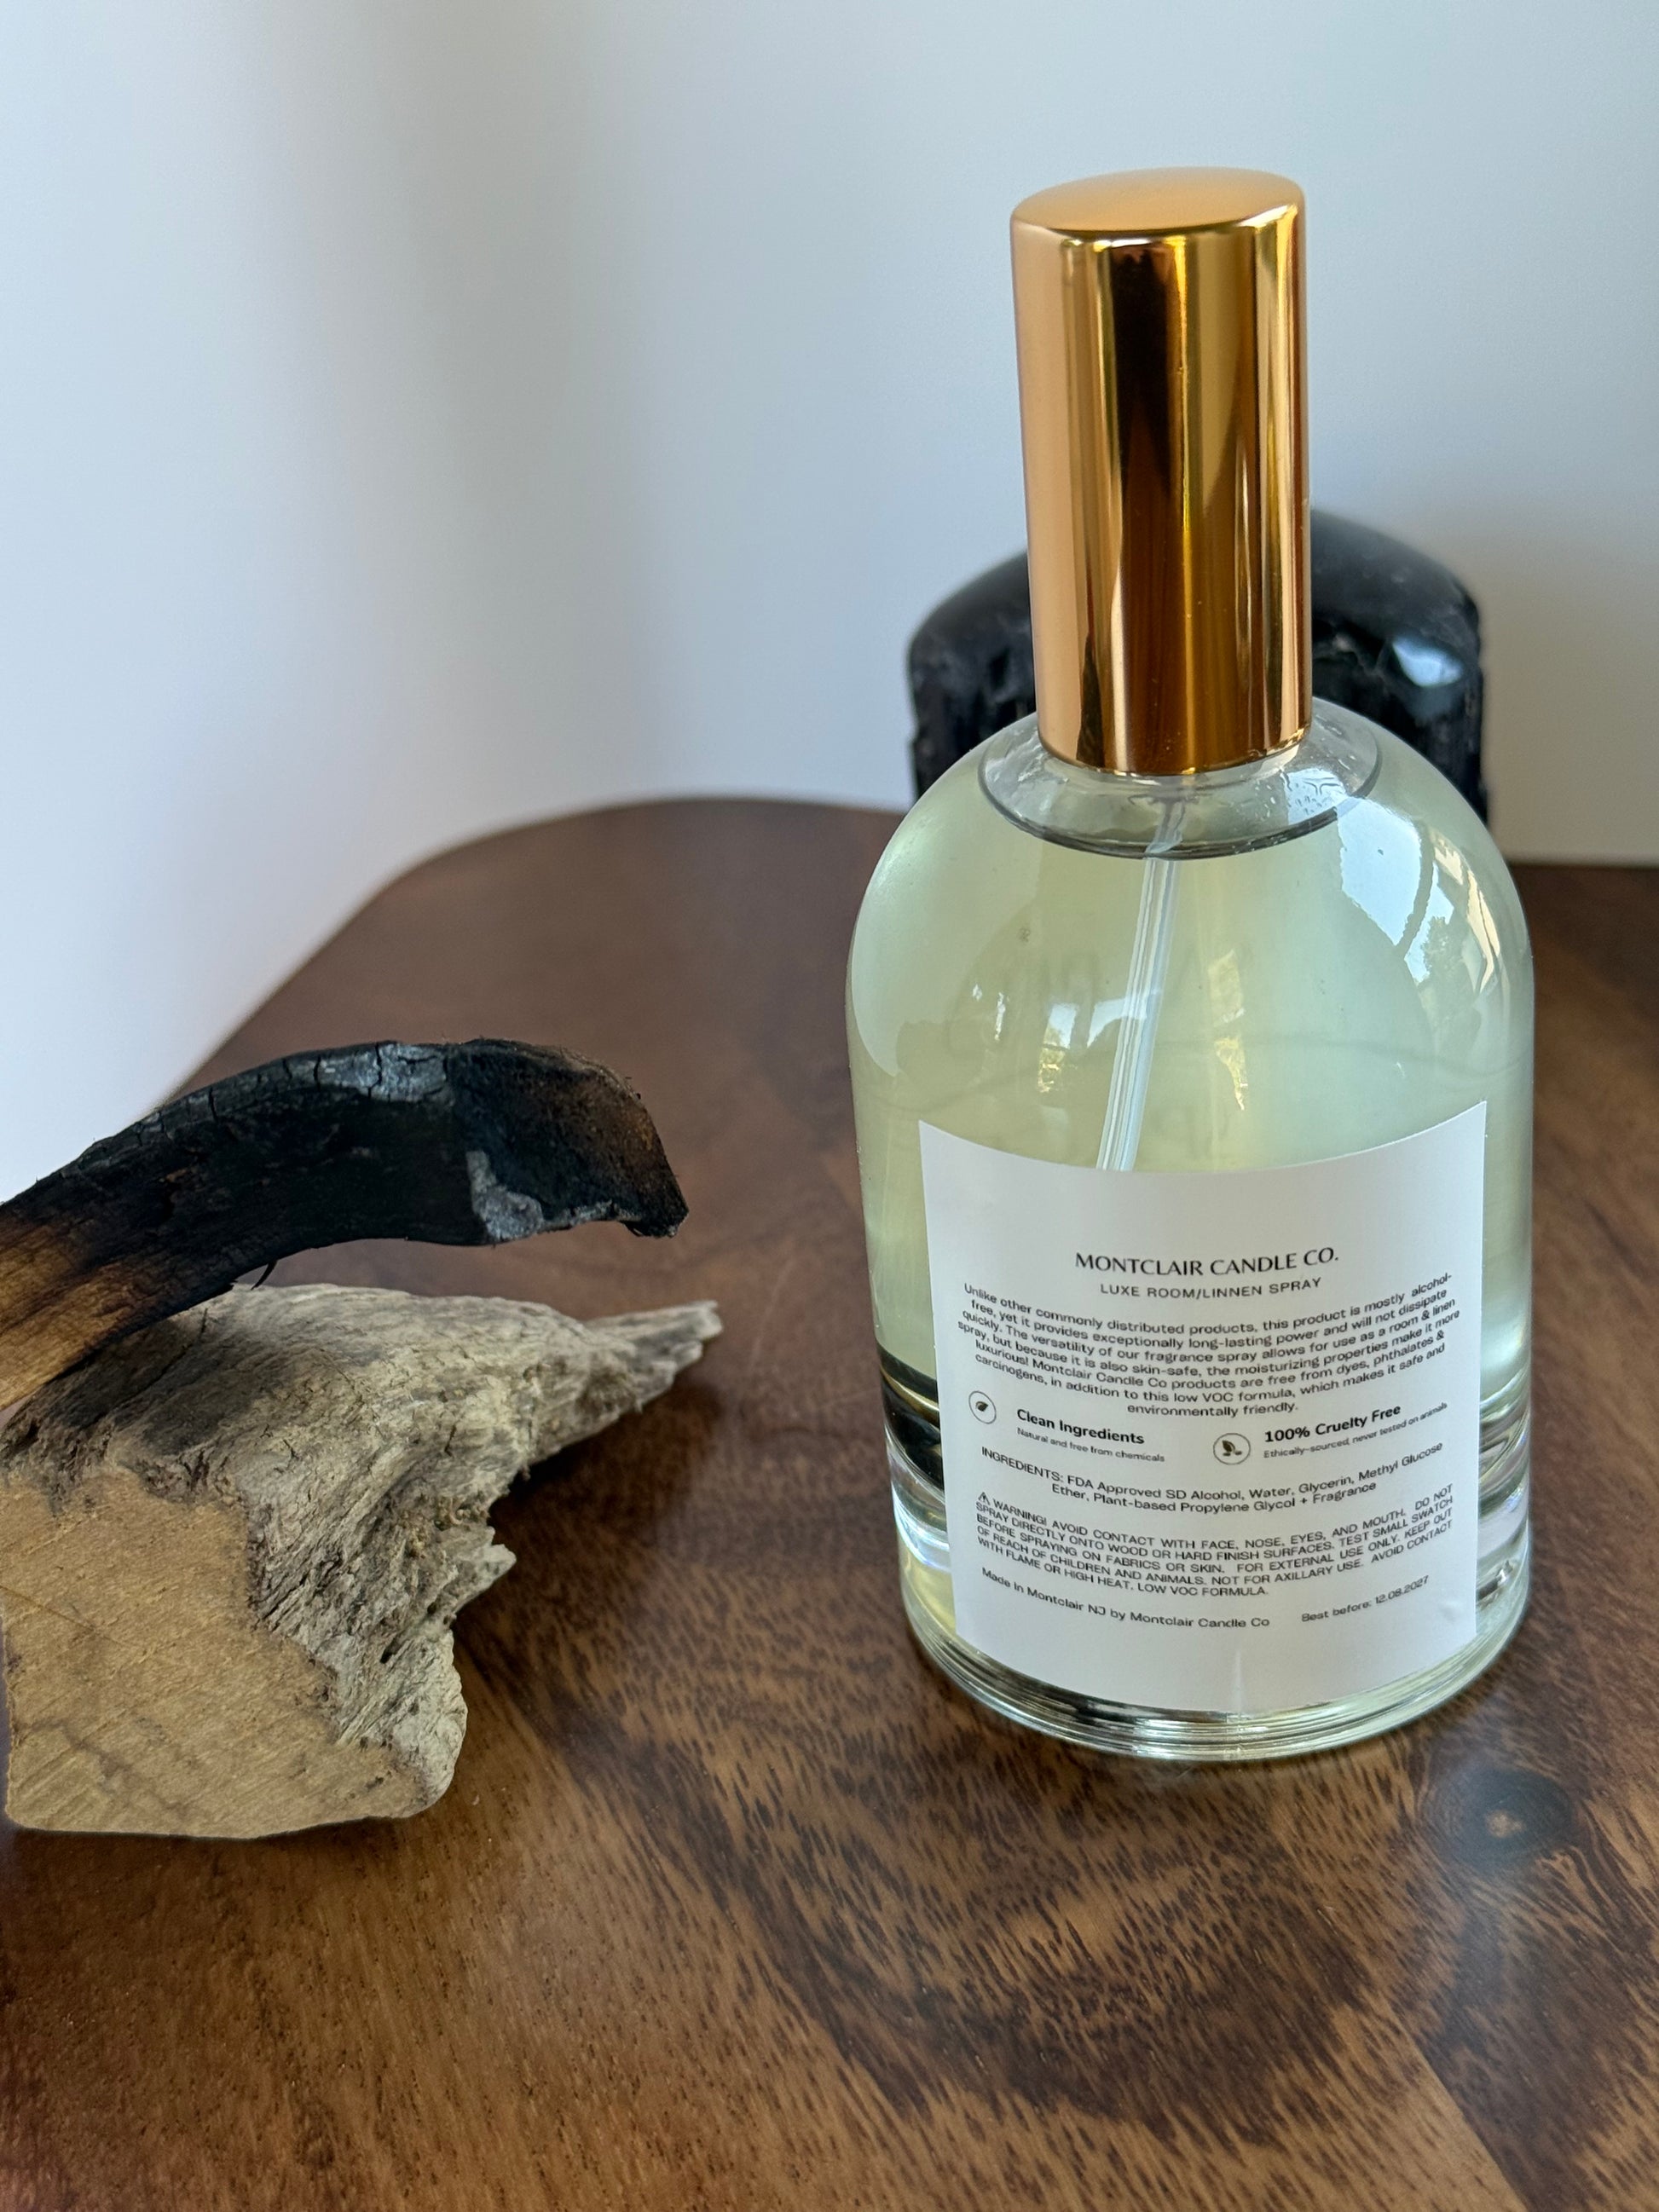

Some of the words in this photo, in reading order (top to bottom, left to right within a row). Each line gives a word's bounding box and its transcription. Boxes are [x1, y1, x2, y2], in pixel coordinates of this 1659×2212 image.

[1075, 1253, 1202, 1275] MONTCLAIR
[1211, 1253, 1297, 1275] CANDLE
[1304, 1247, 1338, 1265] CO.
[1100, 1284, 1140, 1297] LUXE
[1147, 1285, 1262, 1299] ROOM/LINNEN
[1269, 1278, 1321, 1294] SPRAY
[963, 1309, 1003, 1333] quickly.
[1006, 1325, 1028, 1339] The
[1032, 1334, 1095, 1355] versatility
[1118, 1350, 1140, 1360] our
[1145, 1351, 1213, 1364] fragrance
[1217, 1349, 1257, 1364] spray
[1262, 1345, 1306, 1359] allows
[1309, 1343, 1328, 1352] for
[1333, 1337, 1356, 1349] use
[1390, 1317, 1419, 1333] room
[1432, 1299, 1455, 1316] linen
[964, 1284, 997, 1303] Unlike
[1000, 1297, 1032, 1314] other
[1036, 1308, 1103, 1330] commonly
[1107, 1320, 1184, 1334] distributed
[1189, 1324, 1257, 1336] products,
[1263, 1320, 1289, 1331] this
[1293, 1309, 1345, 1330] product
[1364, 1292, 1405, 1313] mostly
[1412, 1273, 1452, 1297] alcohol-
[972, 1300, 997, 1318] free,
[999, 1309, 1016, 1324] yet
[1035, 1320, 1088, 1340] provides
[1093, 1332, 1183, 1350] exceptionally
[1189, 1335, 1272, 1350] long-lasting
[1277, 1330, 1318, 1345] power
[1324, 1324, 1347, 1337] and
[1352, 1316, 1372, 1330] will
[1376, 1309, 1395, 1323] not
[1398, 1289, 1447, 1314] dissipate
[958, 1321, 991, 1342] spray,
[993, 1335, 1012, 1349] but
[1016, 1342, 1067, 1362] because
[1100, 1360, 1128, 1372] also
[1132, 1365, 1202, 1377] skin-safe,
[1207, 1366, 1231, 1376] the
[1235, 1357, 1320, 1375] moisturizing
[1323, 1340, 1388, 1366] properties
[1392, 1330, 1422, 1345] make
[1436, 1309, 1460, 1330] more
[1033, 1359, 1092, 1379] Montclair
[1096, 1372, 1143, 1386] Candle
[1148, 1377, 1166, 1388] Co
[1171, 1379, 1235, 1390] products
[1240, 1377, 1263, 1386] are
[1269, 1373, 1296, 1384] free
[1301, 1369, 1332, 1381] from
[1337, 1359, 1369, 1375] dyes,
[1374, 1336, 1434, 1367] phthalates
[975, 1354, 1048, 1385] carcinogens,
[1066, 1380, 1119, 1398] addition
[1143, 1391, 1170, 1401] this
[1175, 1393, 1198, 1403] low
[1202, 1392, 1234, 1403] VOC
[1239, 1387, 1296, 1401] formula,
[1300, 1379, 1340, 1395] which
[1343, 1369, 1384, 1386] makes
[1399, 1354, 1424, 1371] safe
[1426, 1343, 1446, 1360] and
[1017, 1408, 1055, 1429] Clean
[1059, 1420, 1145, 1444] Ingredients
[1127, 1404, 1238, 1418] environmentally
[1243, 1401, 1298, 1415] friendly.
[1265, 1427, 1310, 1442] 100%
[1315, 1417, 1367, 1435] Cruelty
[1372, 1406, 1402, 1423] Free
[1352, 1430, 1377, 1443] never
[1379, 1420, 1407, 1435] tested
[982, 1447, 1064, 1482] INGREDIENTS:
[1067, 1475, 1094, 1488] FDA
[1097, 1481, 1161, 1499] Approved
[1166, 1489, 1187, 1499] SD
[1191, 1489, 1245, 1501] Alcohol,
[1299, 1476, 1355, 1496] Glycerin,
[1359, 1461, 1398, 1481] Methyl
[1402, 1442, 1442, 1466] Glucose
[1018, 1427, 1049, 1442] Natural
[1070, 1441, 1088, 1452] free
[1115, 1450, 1165, 1462] chemicals
[1052, 1521, 1088, 1536] AVOID
[1093, 1529, 1154, 1546] CONTACT
[1161, 1538, 1195, 1549] WITH
[1332, 1524, 1357, 1536] AND
[1415, 1497, 1430, 1510] DO
[1434, 1484, 1453, 1502] NOT
[1094, 1493, 1176, 1511] Plant-based
[1180, 1502, 1250, 1514] Propylene
[1254, 1499, 1296, 1512] Glycol
[1313, 1481, 1376, 1504] Fragrance
[975, 1502, 1009, 1522] SPRAY
[1011, 1517, 1066, 1541] DIRECTLY
[1069, 1536, 1104, 1550] ONTO
[1108, 1545, 1147, 1556] WOOD
[1153, 1548, 1171, 1558] OR
[1175, 1550, 1212, 1561] HARD
[1217, 1550, 1259, 1560] FINISH
[1263, 1541, 1335, 1558] SURFACES.
[1340, 1531, 1369, 1546] TEST
[1373, 1519, 1408, 1538] SMALL
[1412, 1496, 1453, 1523] SWATCH
[977, 1512, 1015, 1538] BEFORE
[1020, 1533, 1078, 1556] SPRAYING
[1083, 1549, 1101, 1562] ON
[1107, 1555, 1160, 1570] FABRICS
[1166, 1562, 1185, 1572] OR
[1190, 1562, 1224, 1574] SKIN.
[1238, 1562, 1263, 1572] FOR
[1269, 1553, 1334, 1570] EXTERNAL
[1340, 1546, 1364, 1559] USE
[1368, 1538, 1402, 1551] ONLY.
[1405, 1520, 1431, 1538] KEEP
[1434, 1508, 1453, 1524] OUT
[977, 1526, 990, 1538] OF
[993, 1533, 1028, 1553] REACH
[1032, 1546, 1047, 1557] OF
[1050, 1552, 1110, 1575] CHILDREN
[1115, 1568, 1141, 1580] AND
[1146, 1574, 1207, 1585] ANIMALS.
[1212, 1577, 1240, 1585] NOT
[1244, 1574, 1270, 1585] FOR
[1275, 1567, 1333, 1583] AXILLARY
[1337, 1560, 1364, 1572] USE.
[1371, 1545, 1404, 1563] AVOID
[1407, 1519, 1453, 1550] CONTACT
[977, 1536, 1003, 1555] WITH
[1006, 1547, 1040, 1568] FLAME
[1043, 1562, 1061, 1574] OR
[1065, 1568, 1094, 1582] HIGH
[1137, 1583, 1166, 1594] LOW
[1171, 1586, 1199, 1597] VOC
[1202, 1585, 1269, 1597] FORMULA.
[982, 1568, 1011, 1588] Made
[1027, 1587, 1084, 1611] Montclair
[1088, 1604, 1106, 1615] NJ
[1110, 1608, 1125, 1620] by
[1130, 1613, 1194, 1626] Montclair
[1199, 1618, 1246, 1628] Candle
[1251, 1618, 1270, 1627] Co
[1301, 1611, 1329, 1621] Best
[1332, 1600, 1373, 1616] before:
[1376, 1575, 1429, 1604] 12.08.2027
